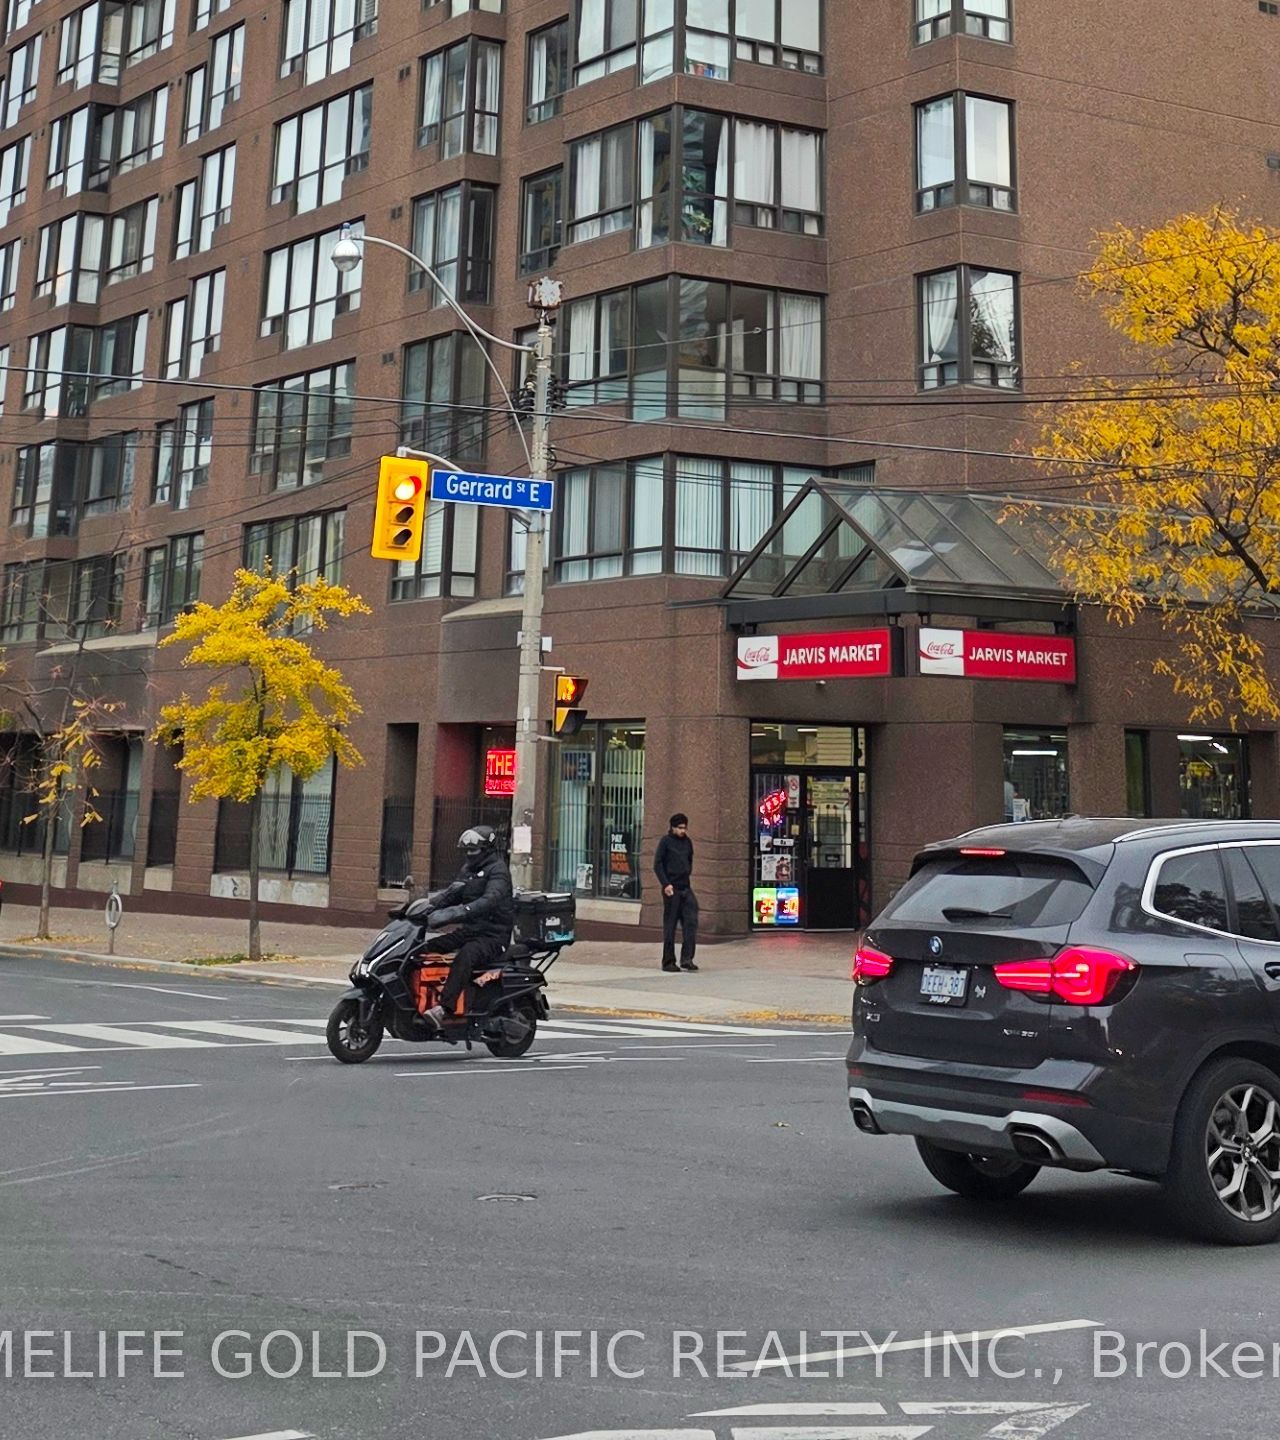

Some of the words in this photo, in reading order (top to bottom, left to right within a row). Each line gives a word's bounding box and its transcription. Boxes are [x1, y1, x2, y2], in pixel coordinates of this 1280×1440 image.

[446, 474, 512, 500] Gerrard
[517, 482, 526, 493] St
[530, 483, 540, 502] E
[783, 646, 826, 665] JARVIS
[829, 643, 882, 663] MARKET
[969, 646, 1013, 662] JARVIS
[1016, 649, 1068, 666] MARKET
[866, 1013, 880, 1022] X3
